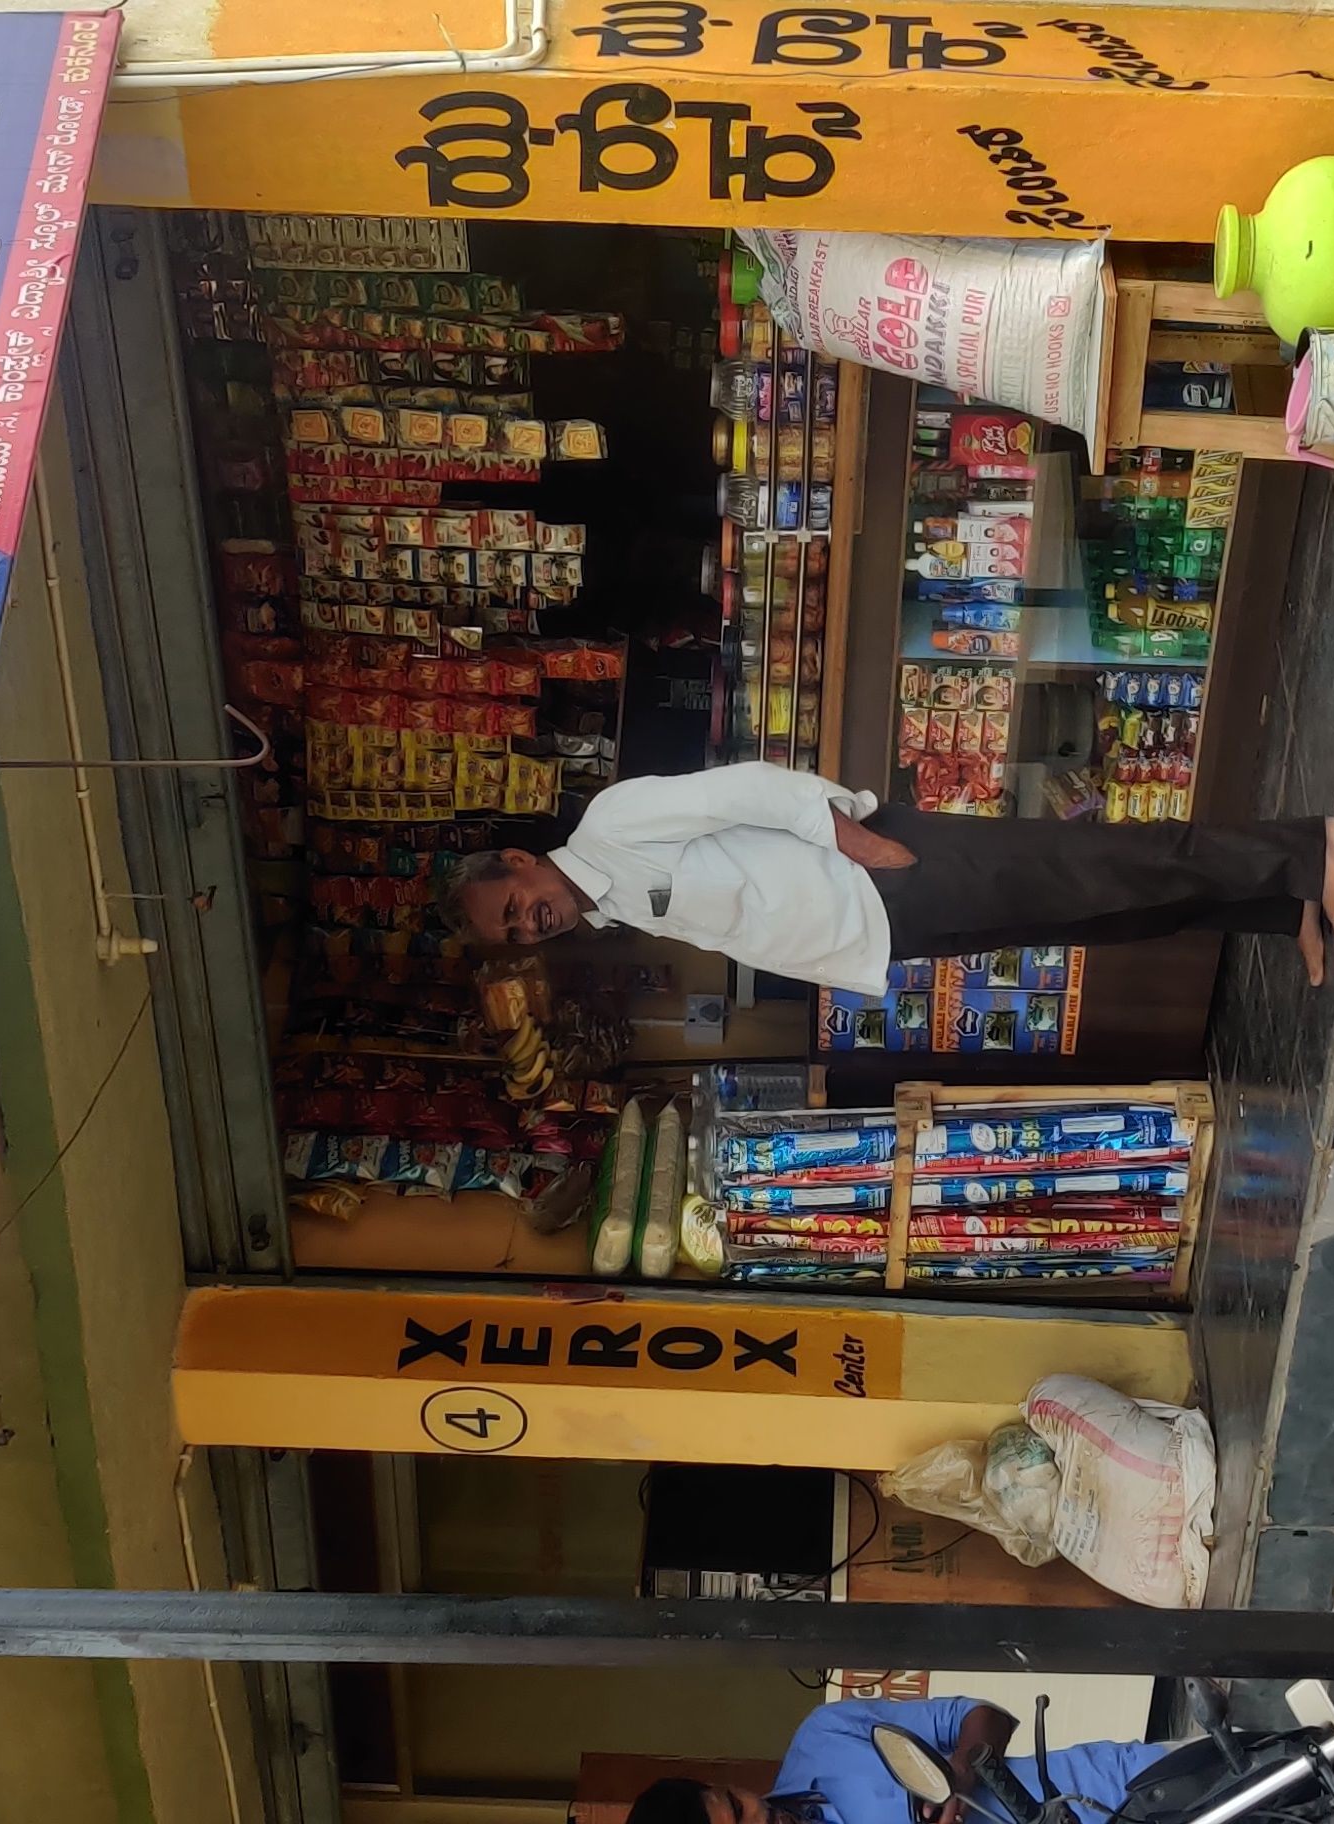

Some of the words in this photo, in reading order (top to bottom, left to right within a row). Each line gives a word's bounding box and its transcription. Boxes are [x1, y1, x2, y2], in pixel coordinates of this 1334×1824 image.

[808, 237, 829, 322] BREAKFAST
[872, 257, 929, 370] GOLD
[961, 288, 987, 326] PURI
[956, 331, 980, 380] SPECIAL
[1045, 324, 1065, 367] HOOKS
[1044, 372, 1060, 389] NO
[397, 1317, 798, 1377] XEROX
[843, 1333, 867, 1398] Center
[444, 1407, 502, 1439] 4
